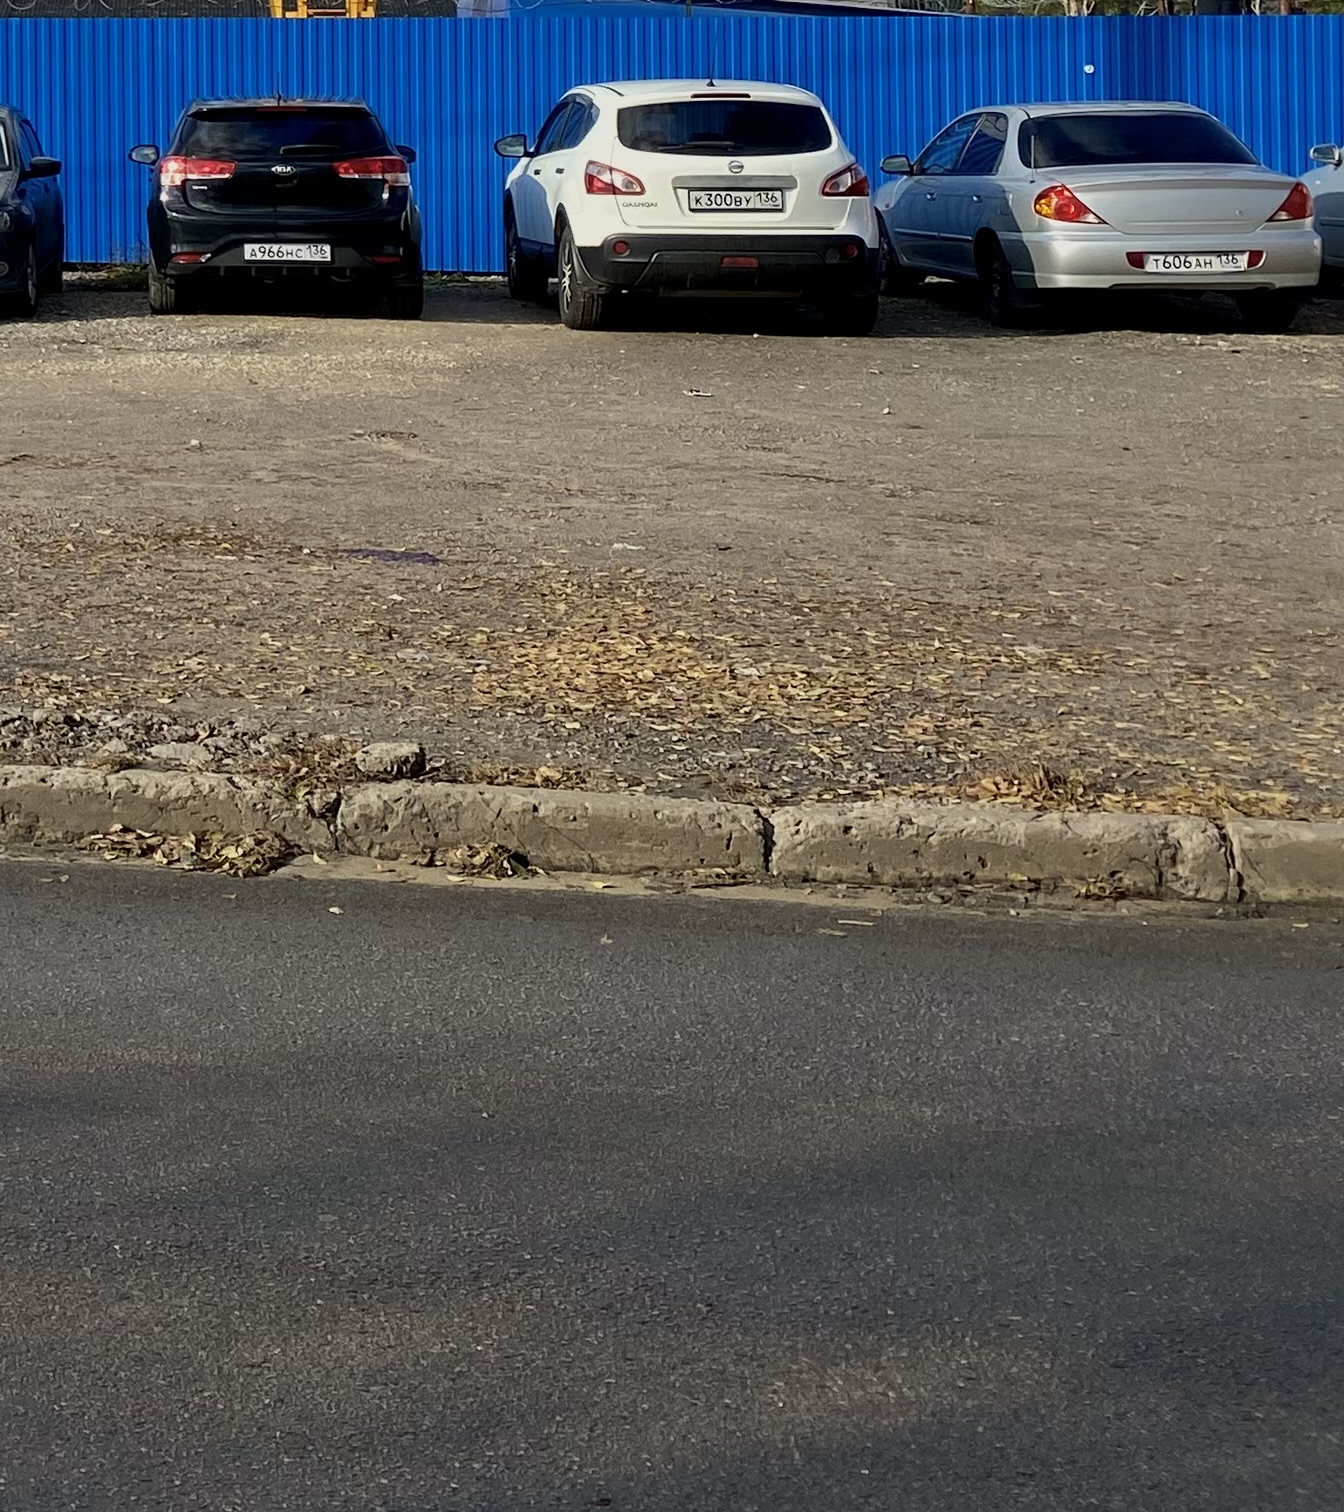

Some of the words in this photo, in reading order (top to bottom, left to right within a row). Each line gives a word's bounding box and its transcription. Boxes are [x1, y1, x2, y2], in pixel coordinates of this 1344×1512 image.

[694, 193, 752, 207] К300ВУ
[756, 192, 778, 204] 136
[249, 245, 304, 259] А966НС
[306, 244, 328, 256] 136
[1153, 255, 1213, 269] Т606АН
[1216, 253, 1239, 265] 136
